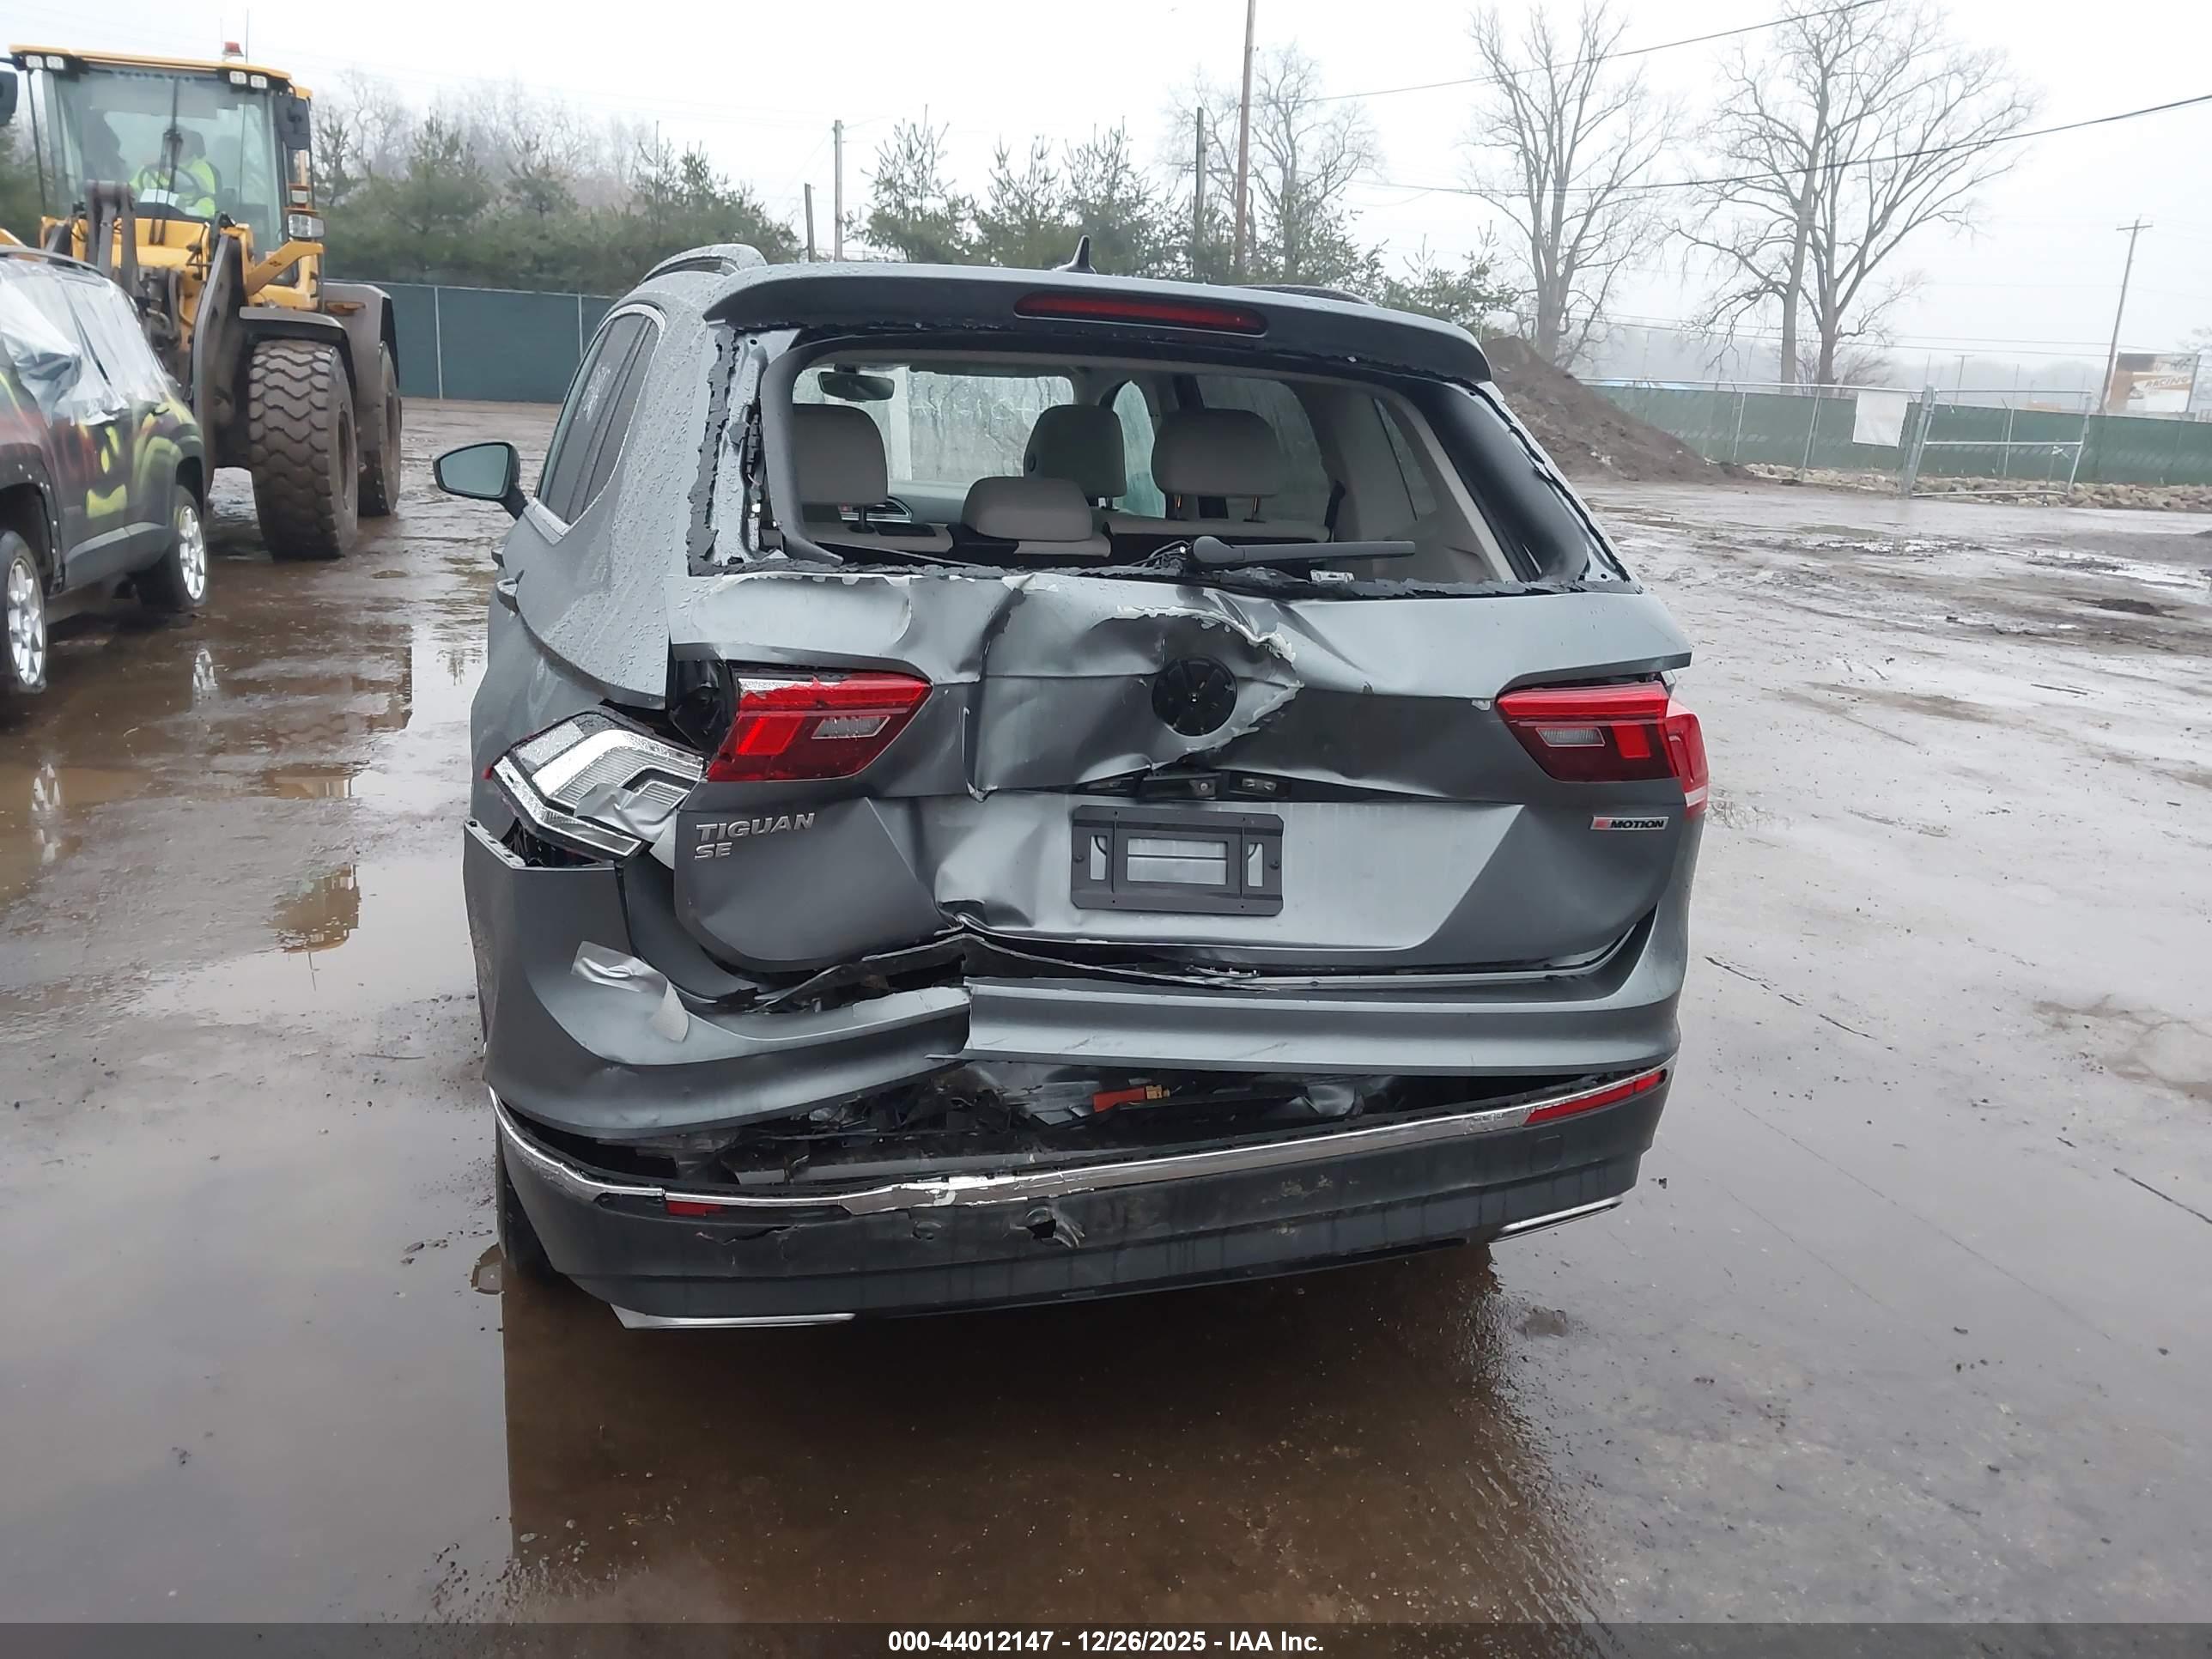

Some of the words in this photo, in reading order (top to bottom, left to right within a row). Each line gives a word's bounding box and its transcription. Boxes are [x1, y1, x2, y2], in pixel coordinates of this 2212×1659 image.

[696, 812, 815, 842] TIGUAN
[1595, 819, 1665, 829] MOTION
[694, 842, 732, 860] SE
